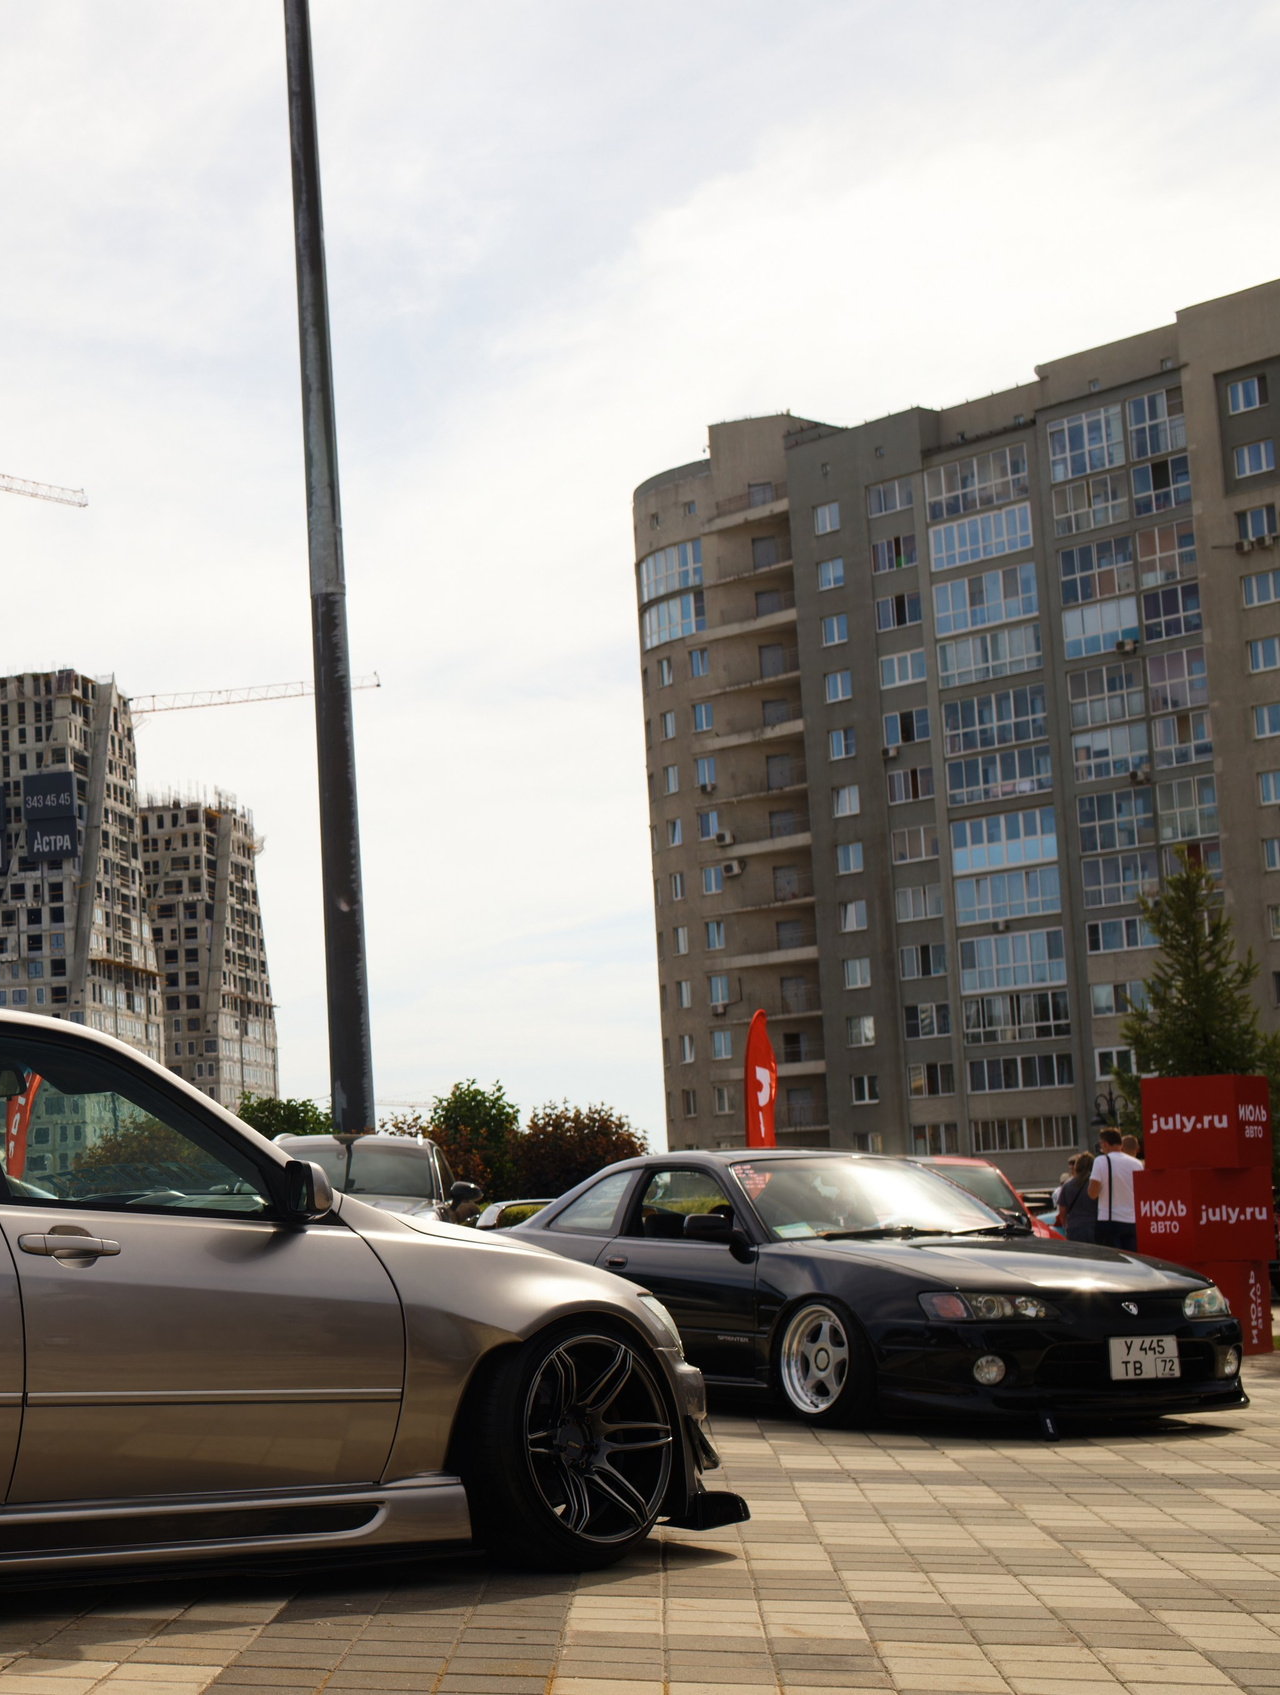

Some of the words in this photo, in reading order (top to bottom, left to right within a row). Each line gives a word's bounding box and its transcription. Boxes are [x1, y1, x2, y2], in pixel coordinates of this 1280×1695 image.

[26, 796, 43, 809] 343
[45, 794, 57, 807] 45
[59, 792, 71, 806] 45
[1238, 1104, 1267, 1122] ИЮЛЬ
[1149, 1113, 1228, 1134] july.ru
[1244, 1125, 1263, 1138] авто
[1140, 1200, 1187, 1218] ИЮЛЬ
[1199, 1204, 1268, 1226] july.ru
[1150, 1220, 1180, 1234] авто
[1248, 1270, 1258, 1345] ИЮЛЬ
[1255, 1282, 1263, 1330] авто
[1139, 1339, 1165, 1356] 445
[1121, 1360, 1143, 1377] ТВ
[1160, 1359, 1175, 1372] 72
